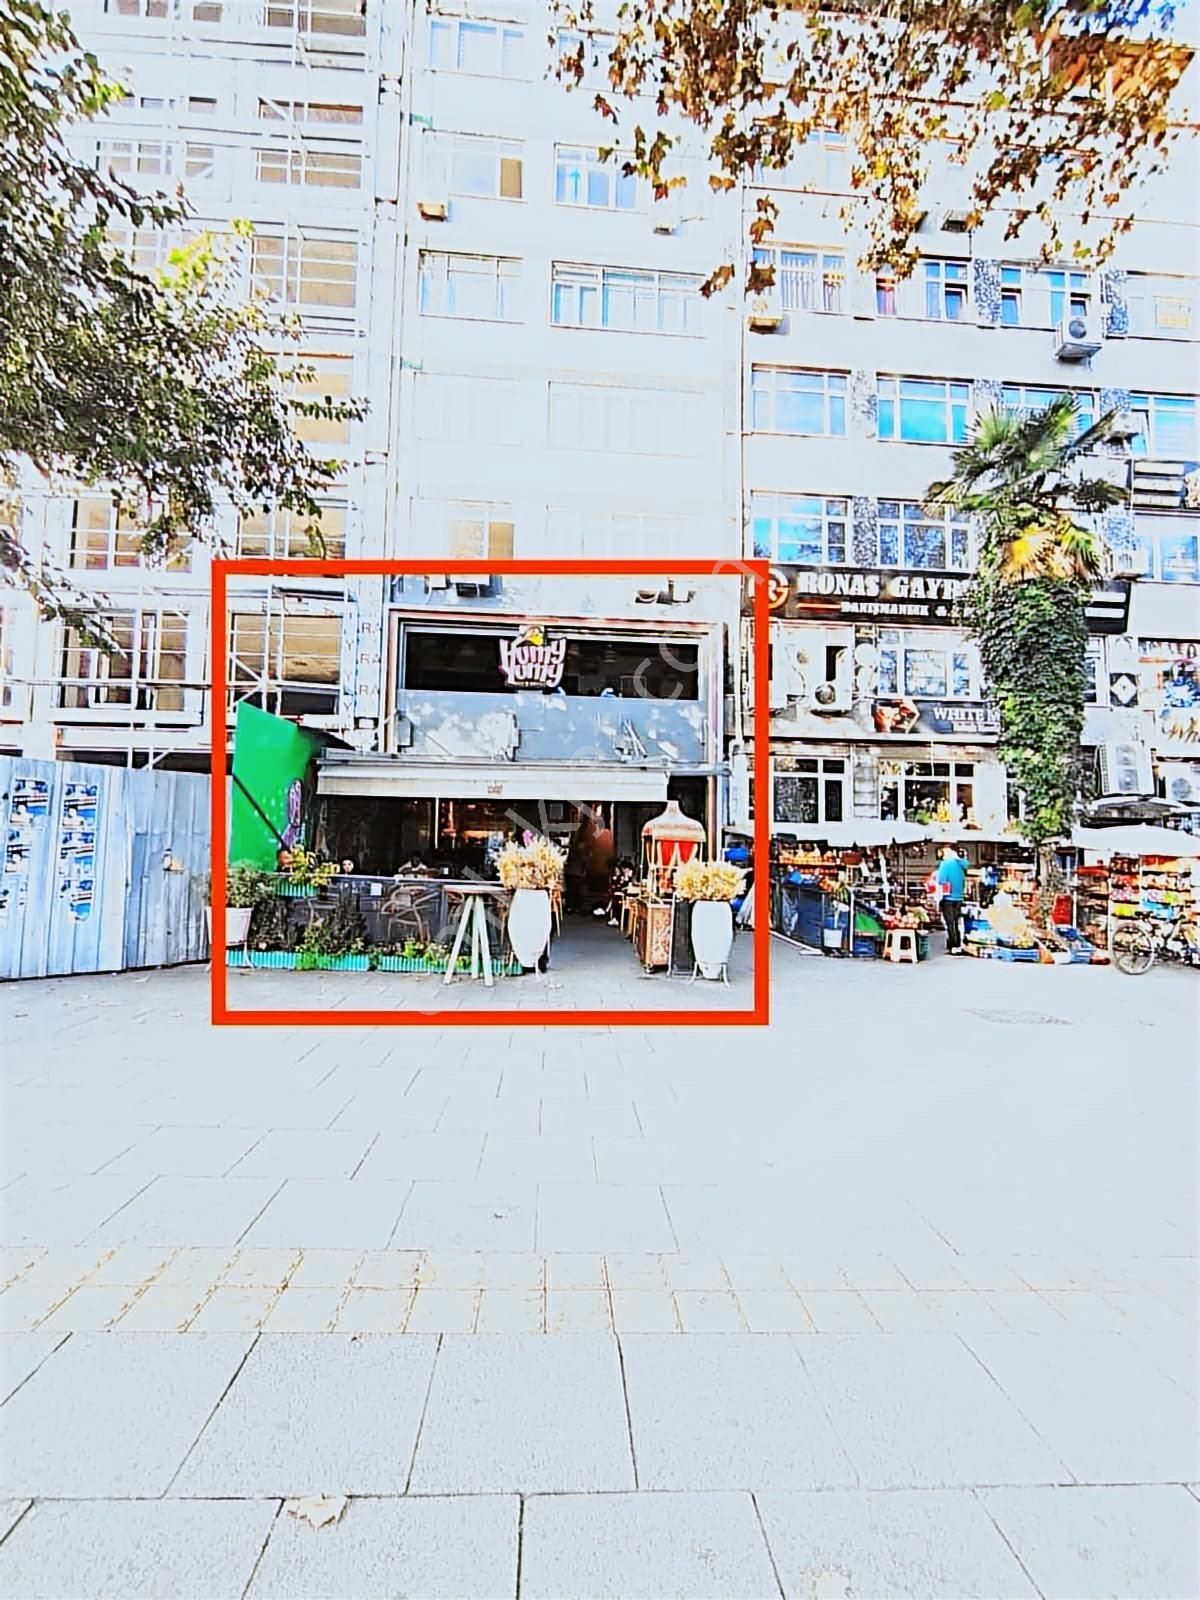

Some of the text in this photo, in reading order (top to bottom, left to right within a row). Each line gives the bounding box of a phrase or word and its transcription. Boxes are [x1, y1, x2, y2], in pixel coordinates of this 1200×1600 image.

[797, 571, 976, 600] RONAS GAYR
[932, 706, 985, 721] WHITE
